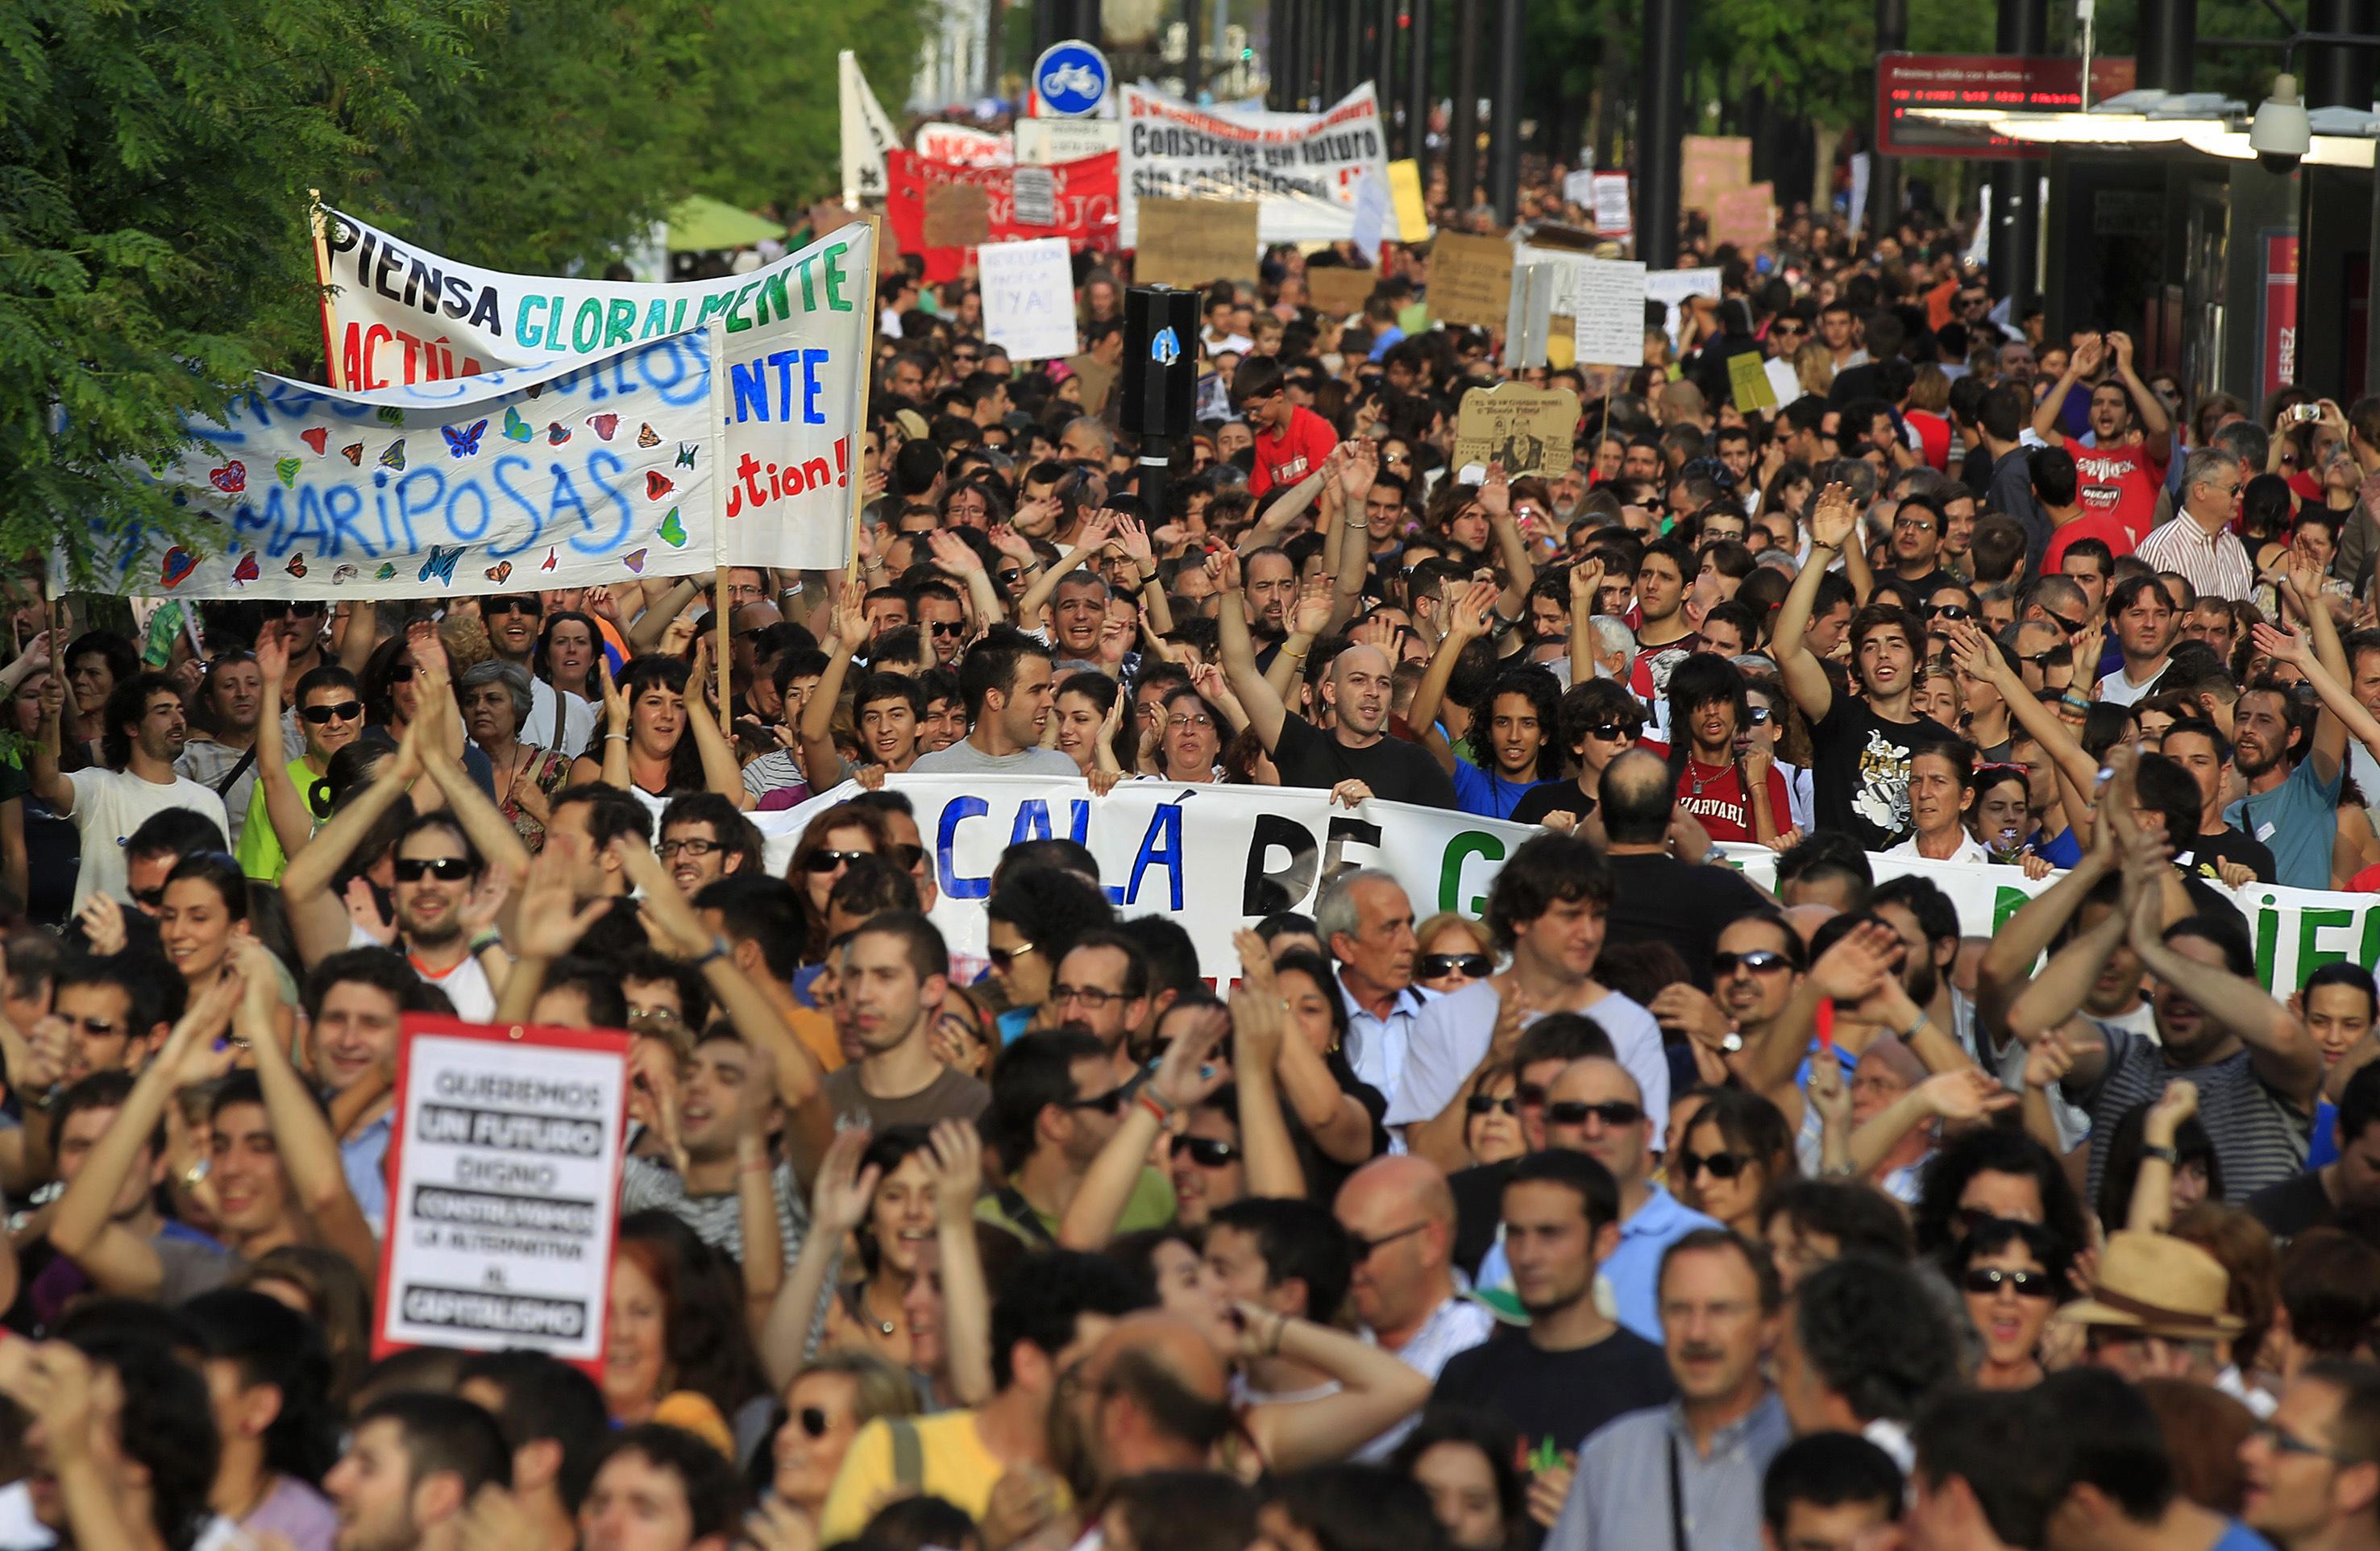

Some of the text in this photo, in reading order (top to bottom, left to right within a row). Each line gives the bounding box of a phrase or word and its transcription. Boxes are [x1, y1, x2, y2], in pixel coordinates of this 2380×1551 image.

[328, 219, 854, 353] PIENSA GLOBALMENTE
[343, 322, 483, 392] ACTÚA
[436, 1070, 600, 1108] QUEREMOS
[418, 1110, 600, 1155] UN FUTURO
[455, 1156, 559, 1188] DIGNO
[405, 1289, 585, 1337] CAPITALISMO
